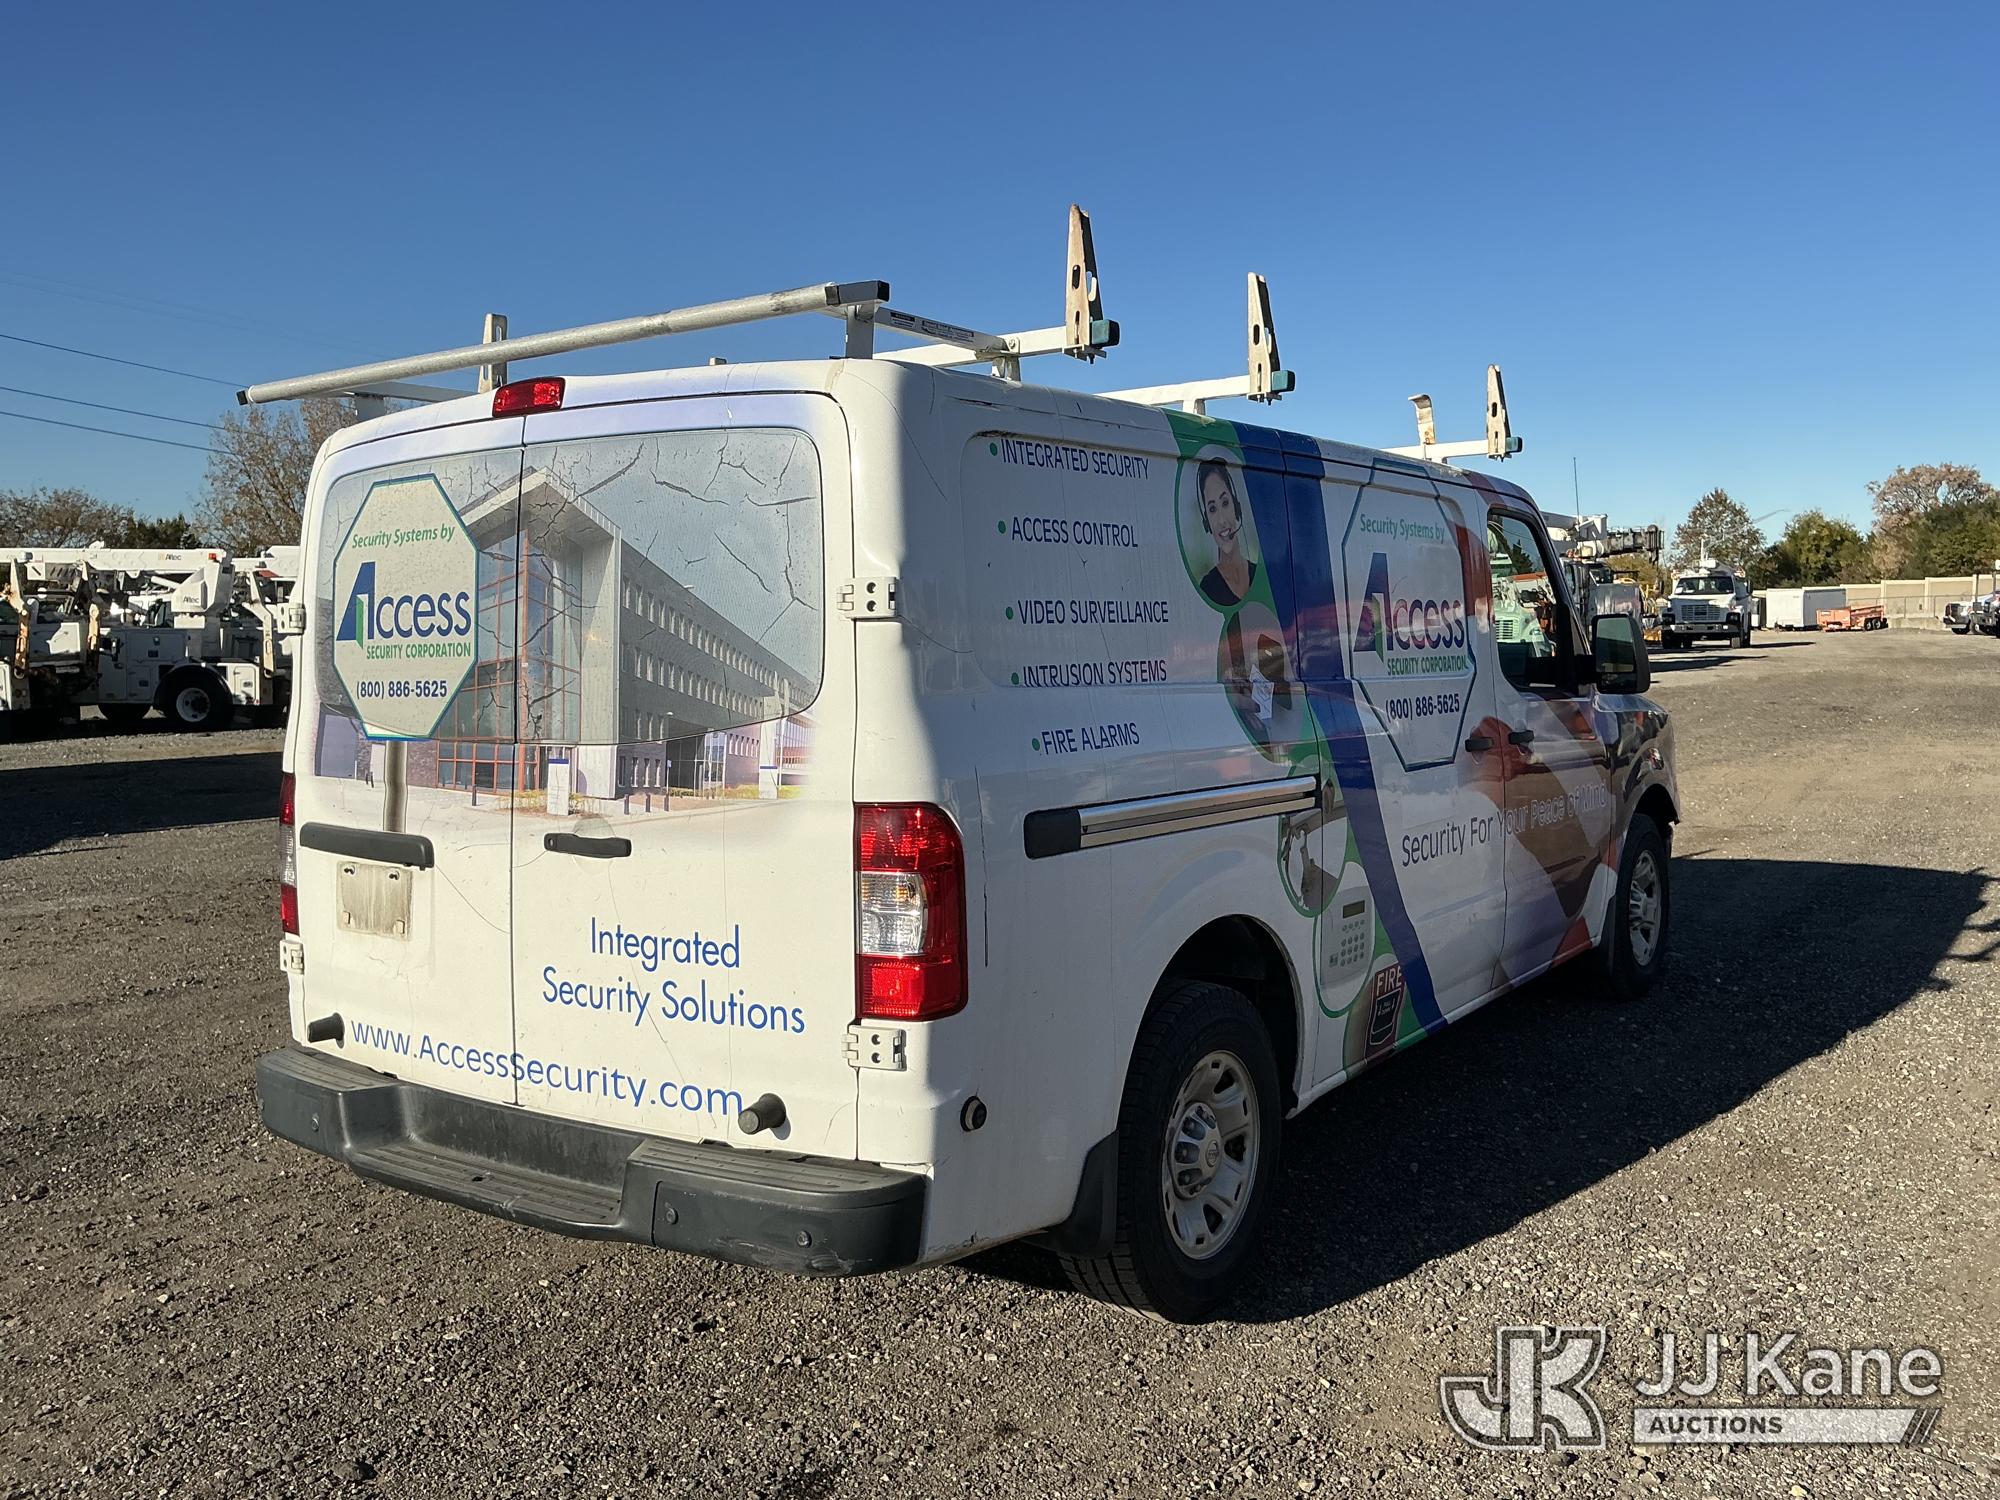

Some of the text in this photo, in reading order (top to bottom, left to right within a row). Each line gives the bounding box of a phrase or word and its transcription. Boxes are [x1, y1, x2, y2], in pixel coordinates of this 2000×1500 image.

[1001, 439, 1149, 480] INTEGRATED SECURITY
[352, 523, 455, 549] Security Systems by
[1012, 517, 1138, 548] ACCESS CONTROL
[1360, 513, 1445, 544] Security Systems by
[336, 561, 472, 642] Access
[1018, 600, 1169, 624] VIDEO SURVEILLANCE
[1354, 552, 1465, 651] Access
[366, 642, 471, 660] SECURITY CORPORATION
[1387, 654, 1468, 676] SECURITY CORPORATION
[1023, 659, 1167, 687] INTRUSION SYSTEMS
[356, 680, 448, 700] (800) 886-5625
[1385, 693, 1460, 722] (800) 886-5625
[1041, 722, 1140, 755] FIRE ALARMS
[1402, 778, 1607, 867] Security For Your Peace of Mind
[591, 917, 740, 971] Integrated
[1376, 965, 1402, 997] FIRE
[543, 966, 805, 1034] Security Solutions
[350, 1019, 743, 1117] www.AccessSecurity.com
